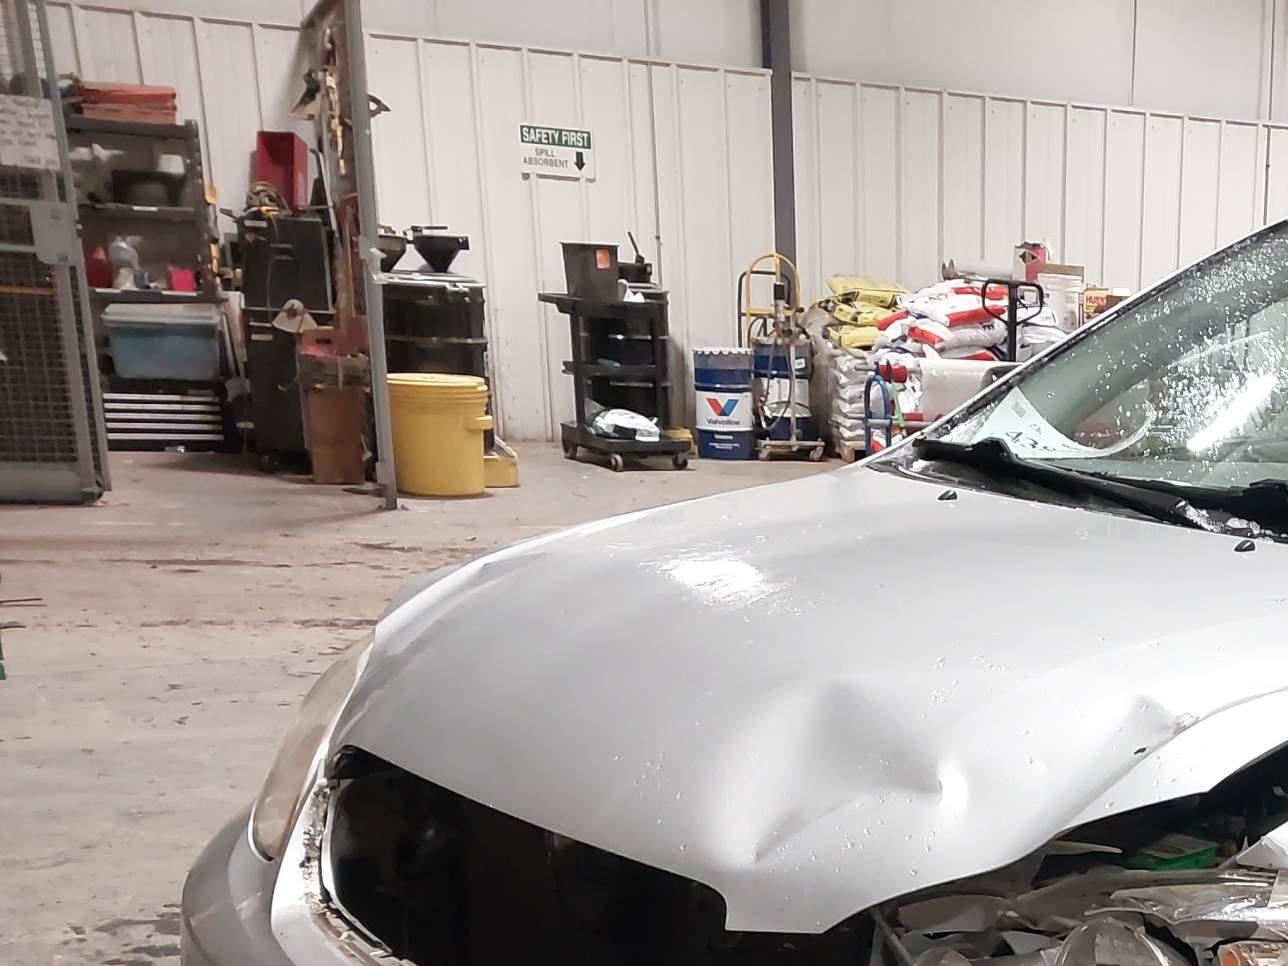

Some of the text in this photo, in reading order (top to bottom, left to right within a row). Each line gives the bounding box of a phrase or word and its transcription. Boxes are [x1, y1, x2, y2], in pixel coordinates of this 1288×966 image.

[522, 127, 589, 147] SAFETY FIRST
[535, 148, 556, 158] SPILL
[523, 156, 568, 168] ABSORBENT
[706, 417, 741, 426] Valvoline
